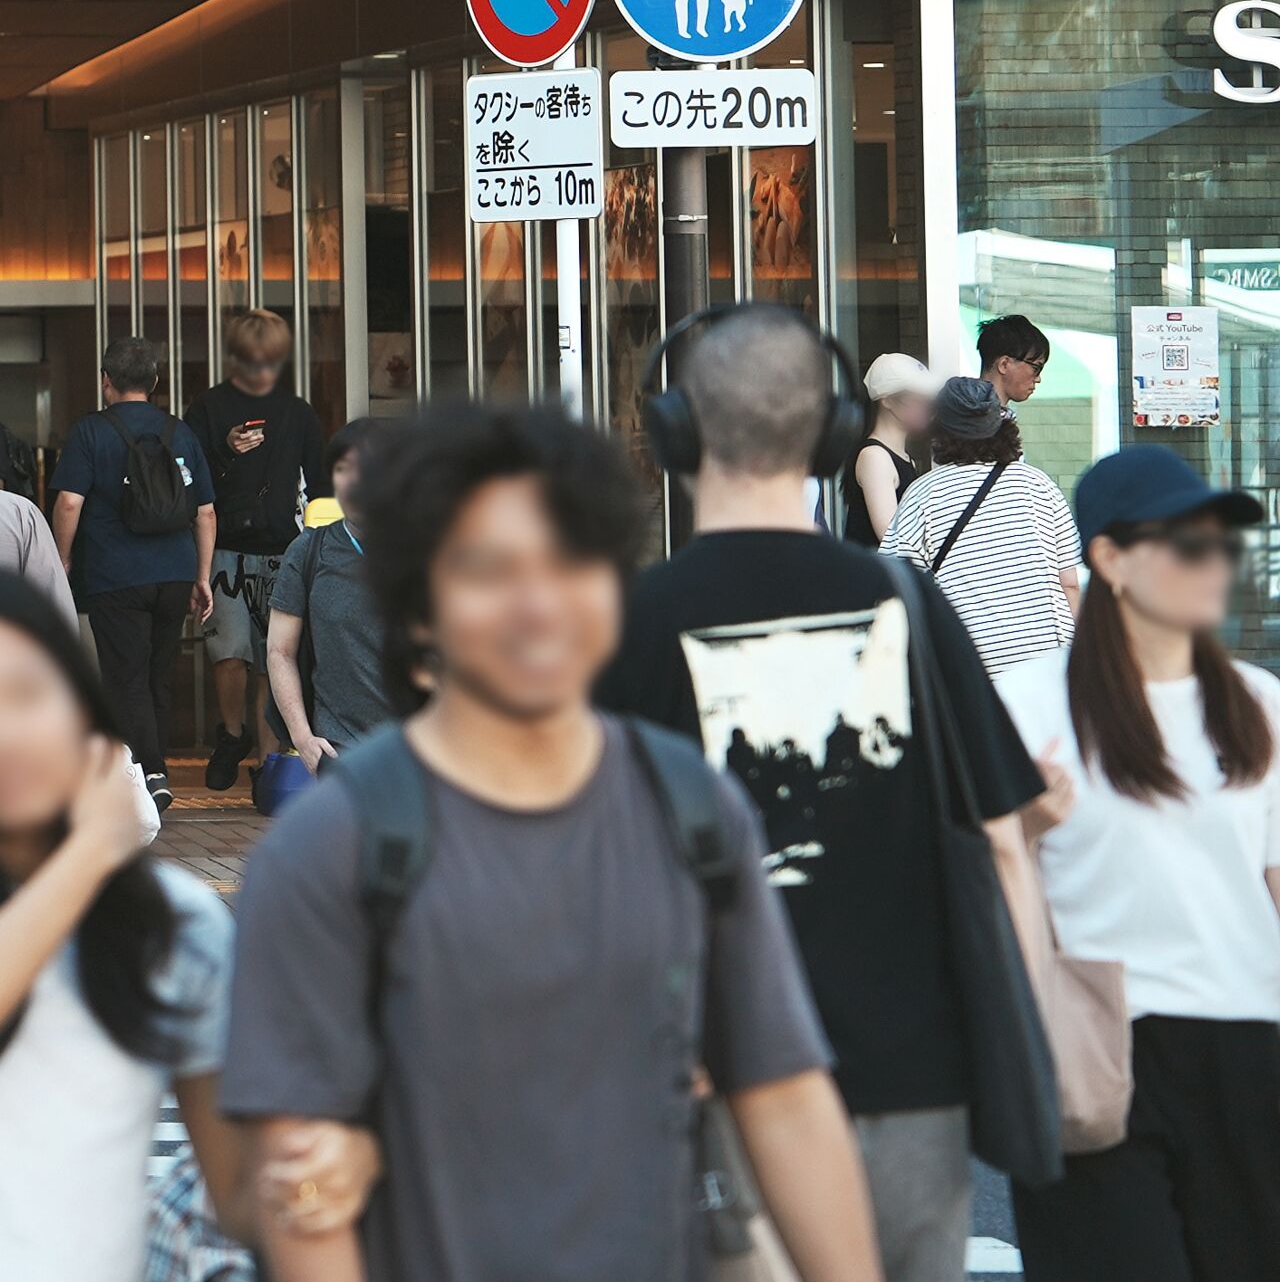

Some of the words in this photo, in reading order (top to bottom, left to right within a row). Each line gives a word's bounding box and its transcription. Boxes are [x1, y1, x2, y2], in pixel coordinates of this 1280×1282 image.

[474, 83, 591, 125] タクシーの客待ち
[622, 86, 808, 130] この先20m
[475, 131, 530, 166] を除く
[476, 175, 541, 208] ここから
[555, 170, 596, 206] 10m
[1166, 324, 1204, 333] YouTube
